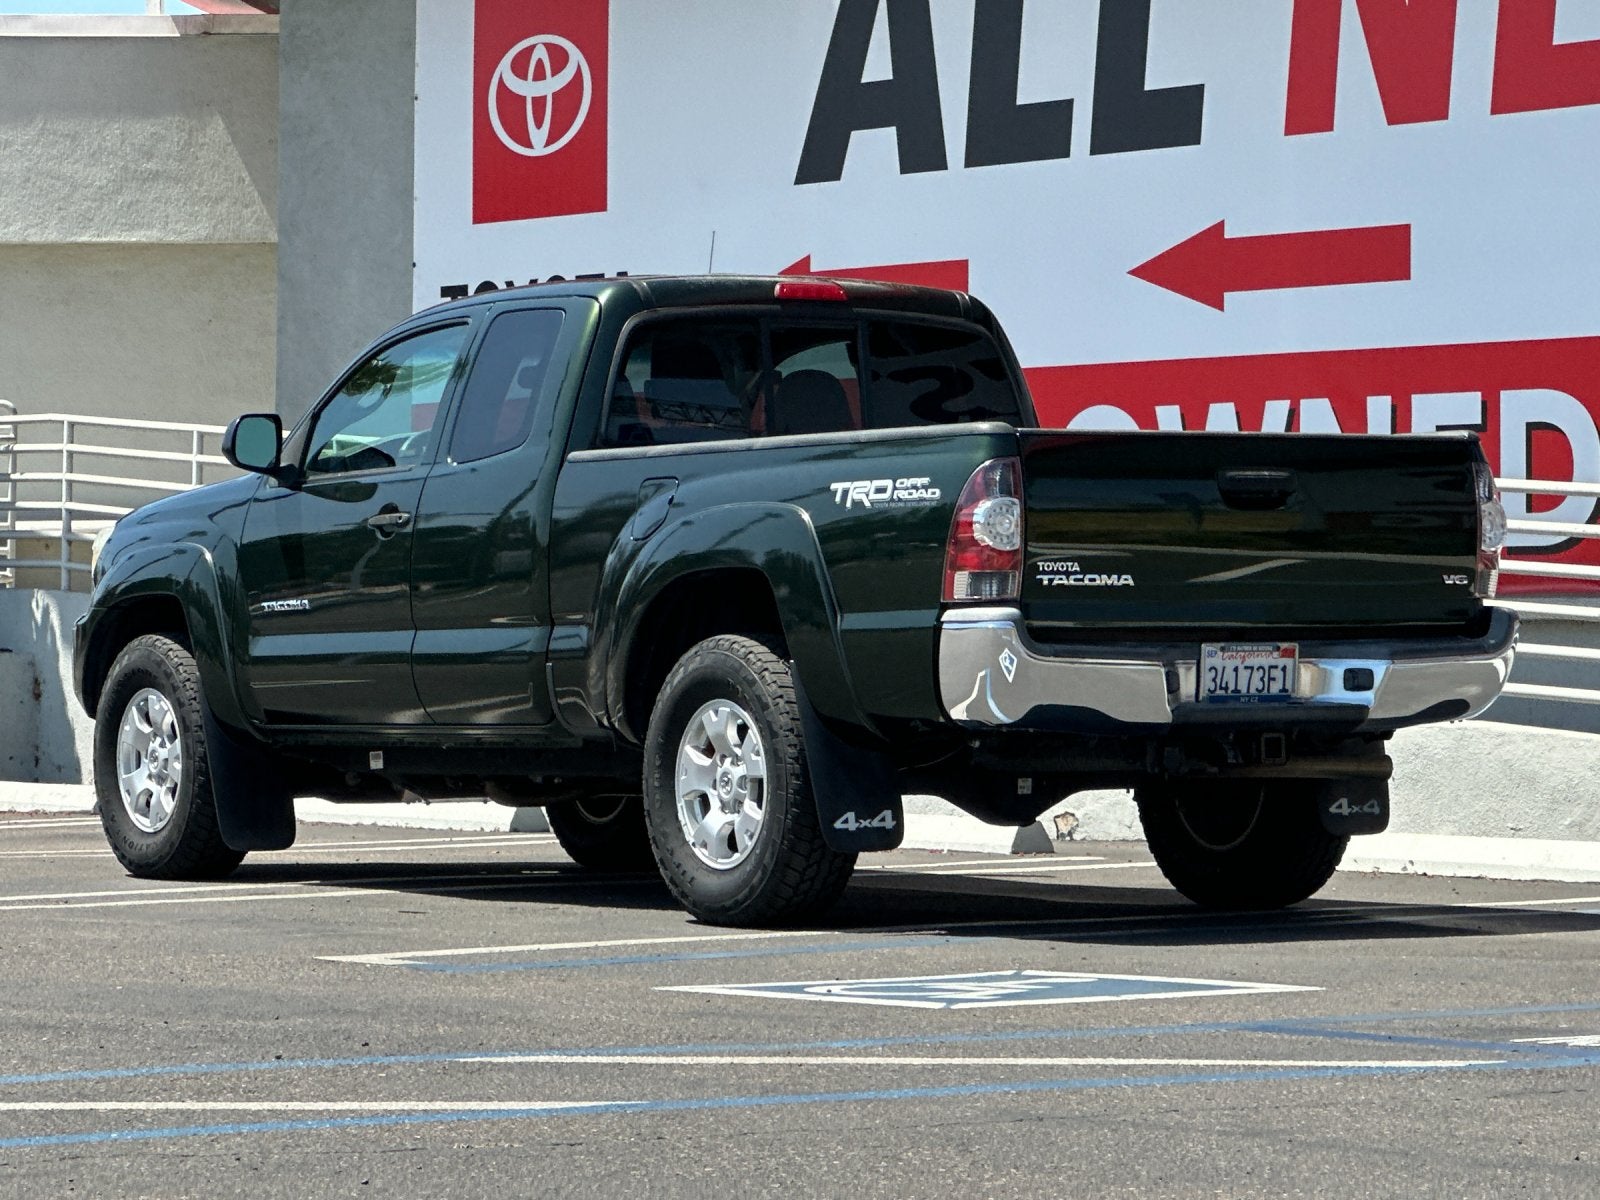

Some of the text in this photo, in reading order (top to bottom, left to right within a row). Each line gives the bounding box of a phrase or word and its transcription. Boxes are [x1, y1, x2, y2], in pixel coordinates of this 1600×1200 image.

[793, 0, 1205, 186] ALL
[830, 477, 930, 509] TRD OFF
[893, 488, 941, 501] ROAD
[1037, 562, 1080, 572] TOYOTA
[1036, 574, 1135, 587] TACOMA
[1442, 574, 1468, 585] V6
[1207, 665, 1289, 694] 34173F1
[1329, 797, 1380, 816] 4x4
[834, 810, 896, 831] 4x4
